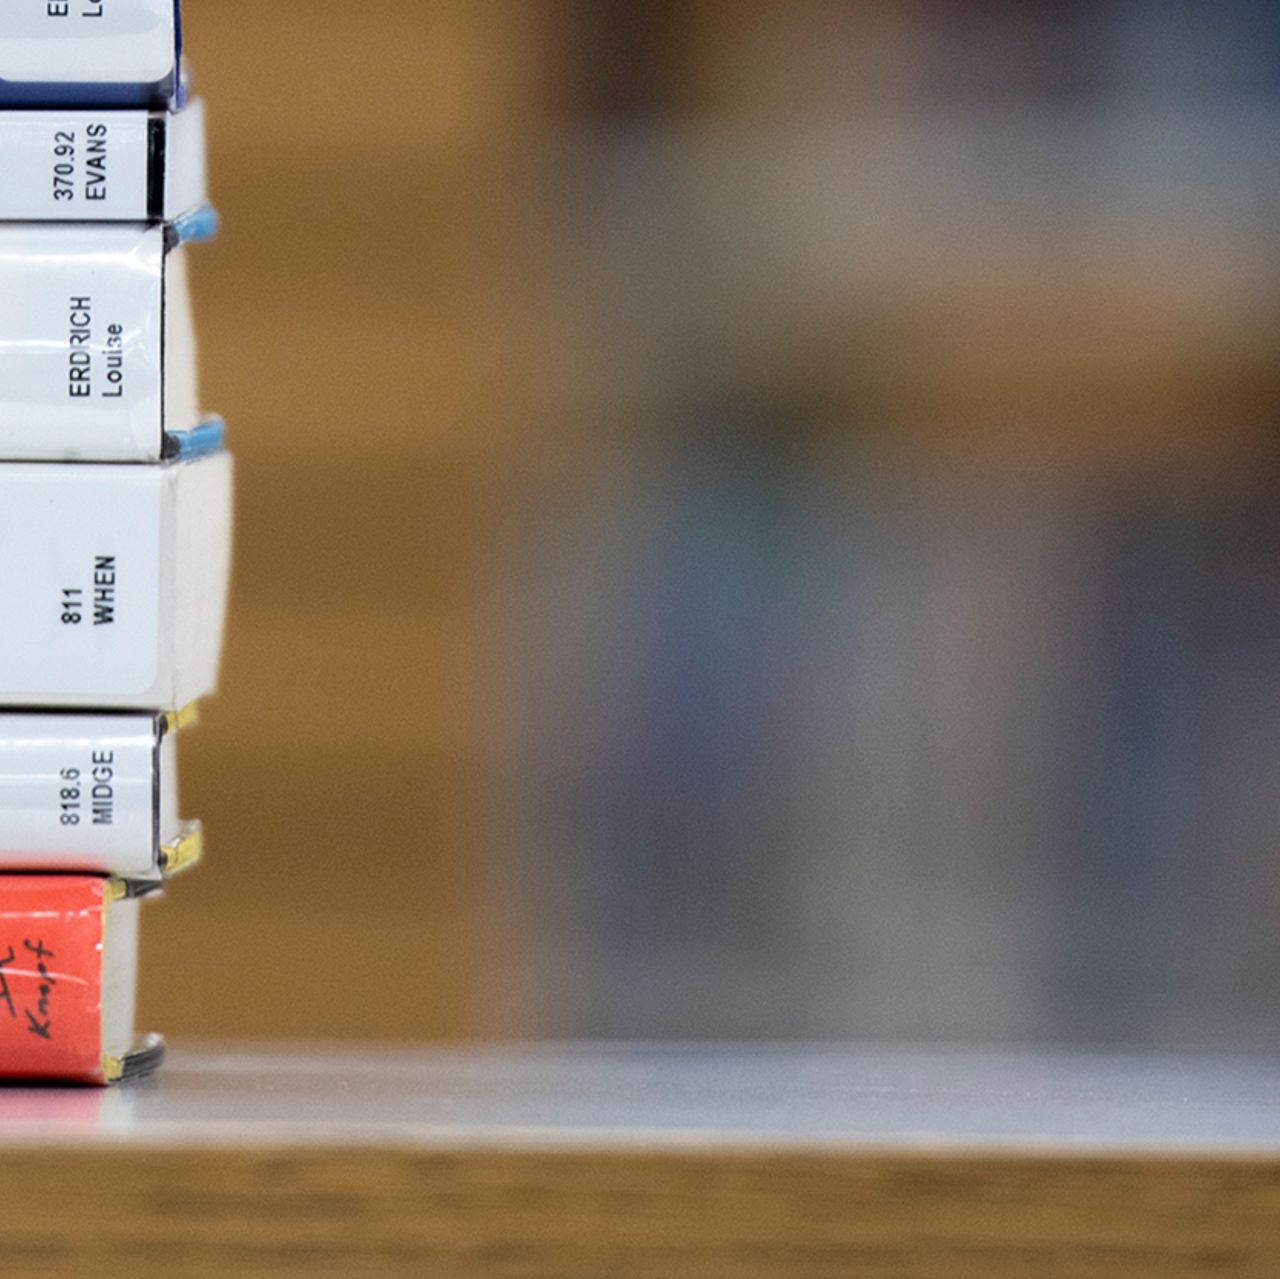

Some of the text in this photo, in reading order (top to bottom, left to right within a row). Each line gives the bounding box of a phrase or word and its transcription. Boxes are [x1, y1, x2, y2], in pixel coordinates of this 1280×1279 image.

[54, 131, 75, 201] 370.92
[87, 123, 107, 201] EVANS
[69, 296, 91, 398] ERDRICH
[102, 323, 123, 397] Louise
[63, 586, 82, 625] 811
[94, 554, 115, 625] WHEN
[60, 767, 81, 826] 818.6
[93, 750, 114, 826] MIDGE
